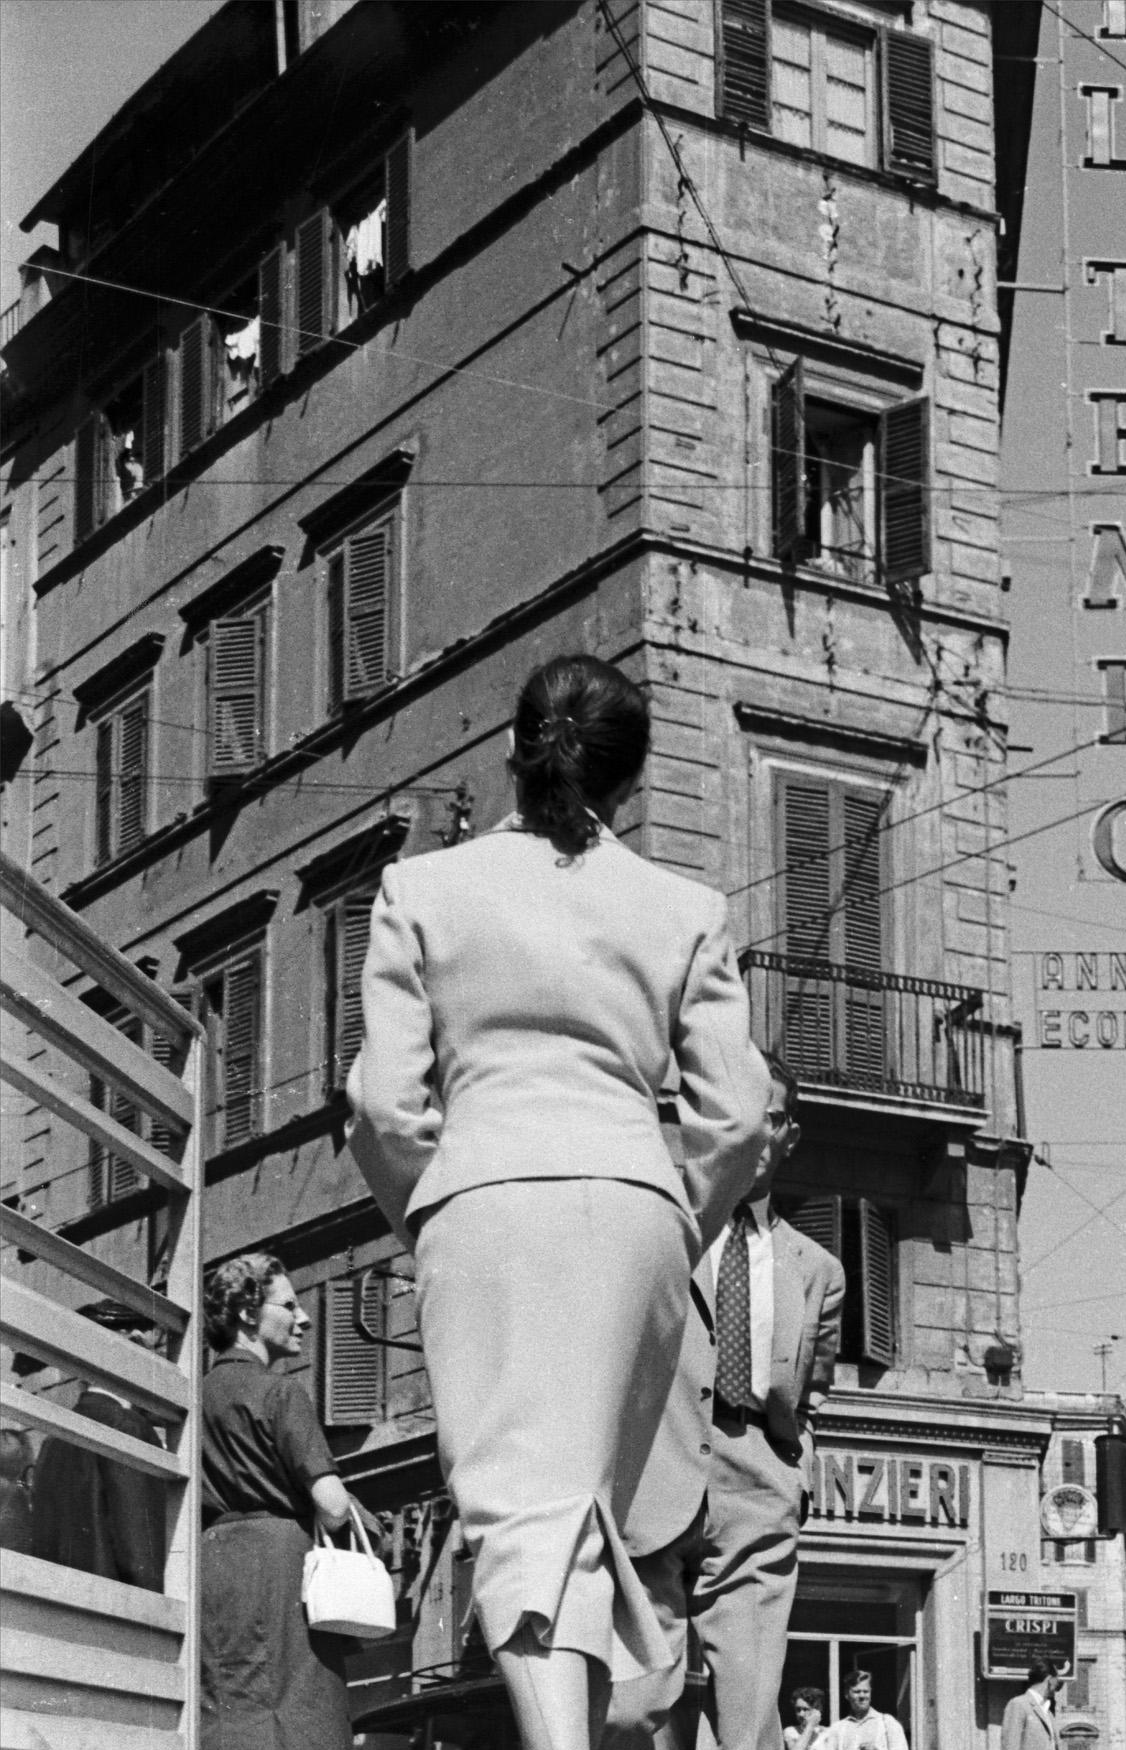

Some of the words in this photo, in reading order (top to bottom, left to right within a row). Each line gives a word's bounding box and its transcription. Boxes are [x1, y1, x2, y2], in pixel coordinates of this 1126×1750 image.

[1001, 1552, 1027, 1572] 120
[1000, 1594, 1026, 1605] LARGO
[1029, 1595, 1061, 1607] TRITONE
[1005, 1619, 1058, 1634] CRISPI
